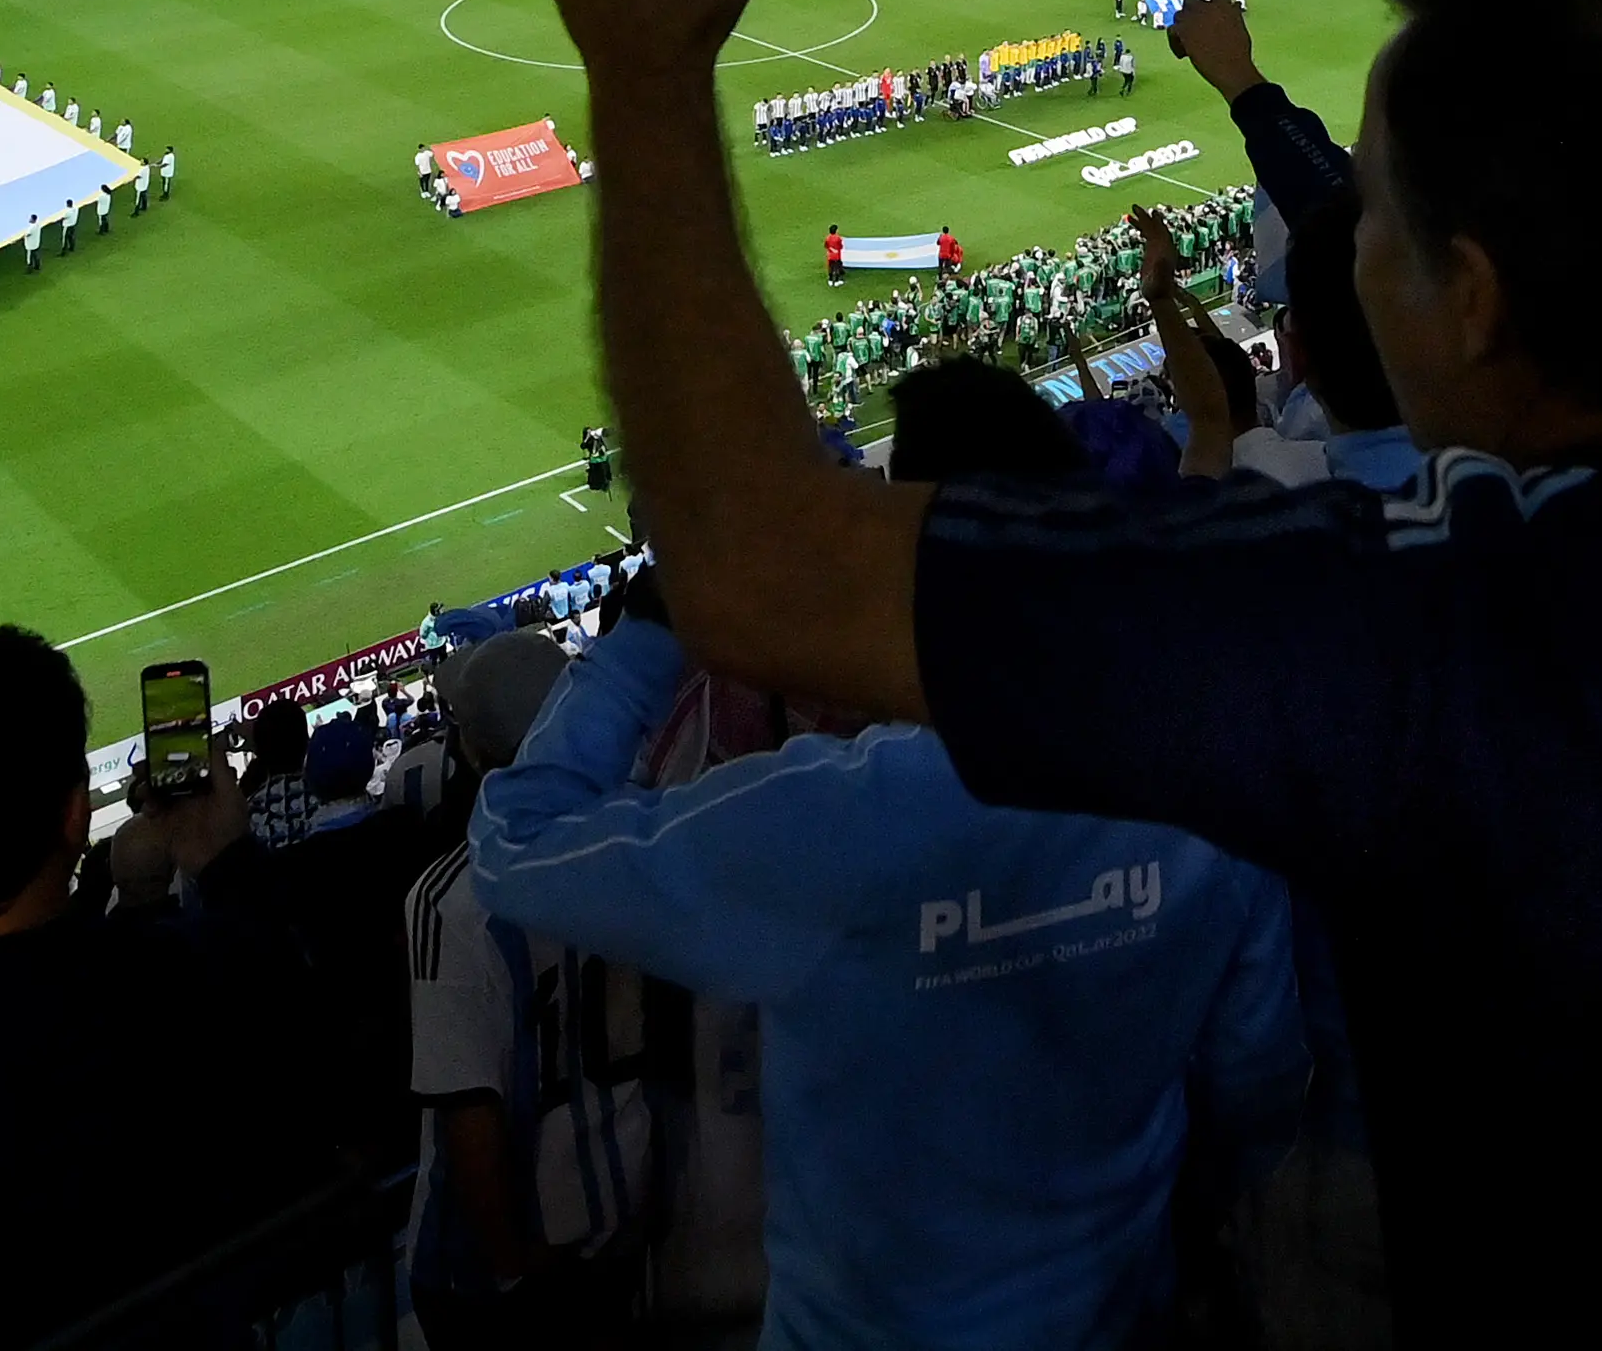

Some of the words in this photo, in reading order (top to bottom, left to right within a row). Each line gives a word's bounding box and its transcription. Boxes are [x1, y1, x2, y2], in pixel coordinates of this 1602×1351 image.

[1105, 117, 1138, 138] CUP
[487, 138, 550, 167] EDUCATION
[495, 161, 516, 178] FOR
[516, 157, 539, 173] ALL
[89, 756, 121, 776] ergy
